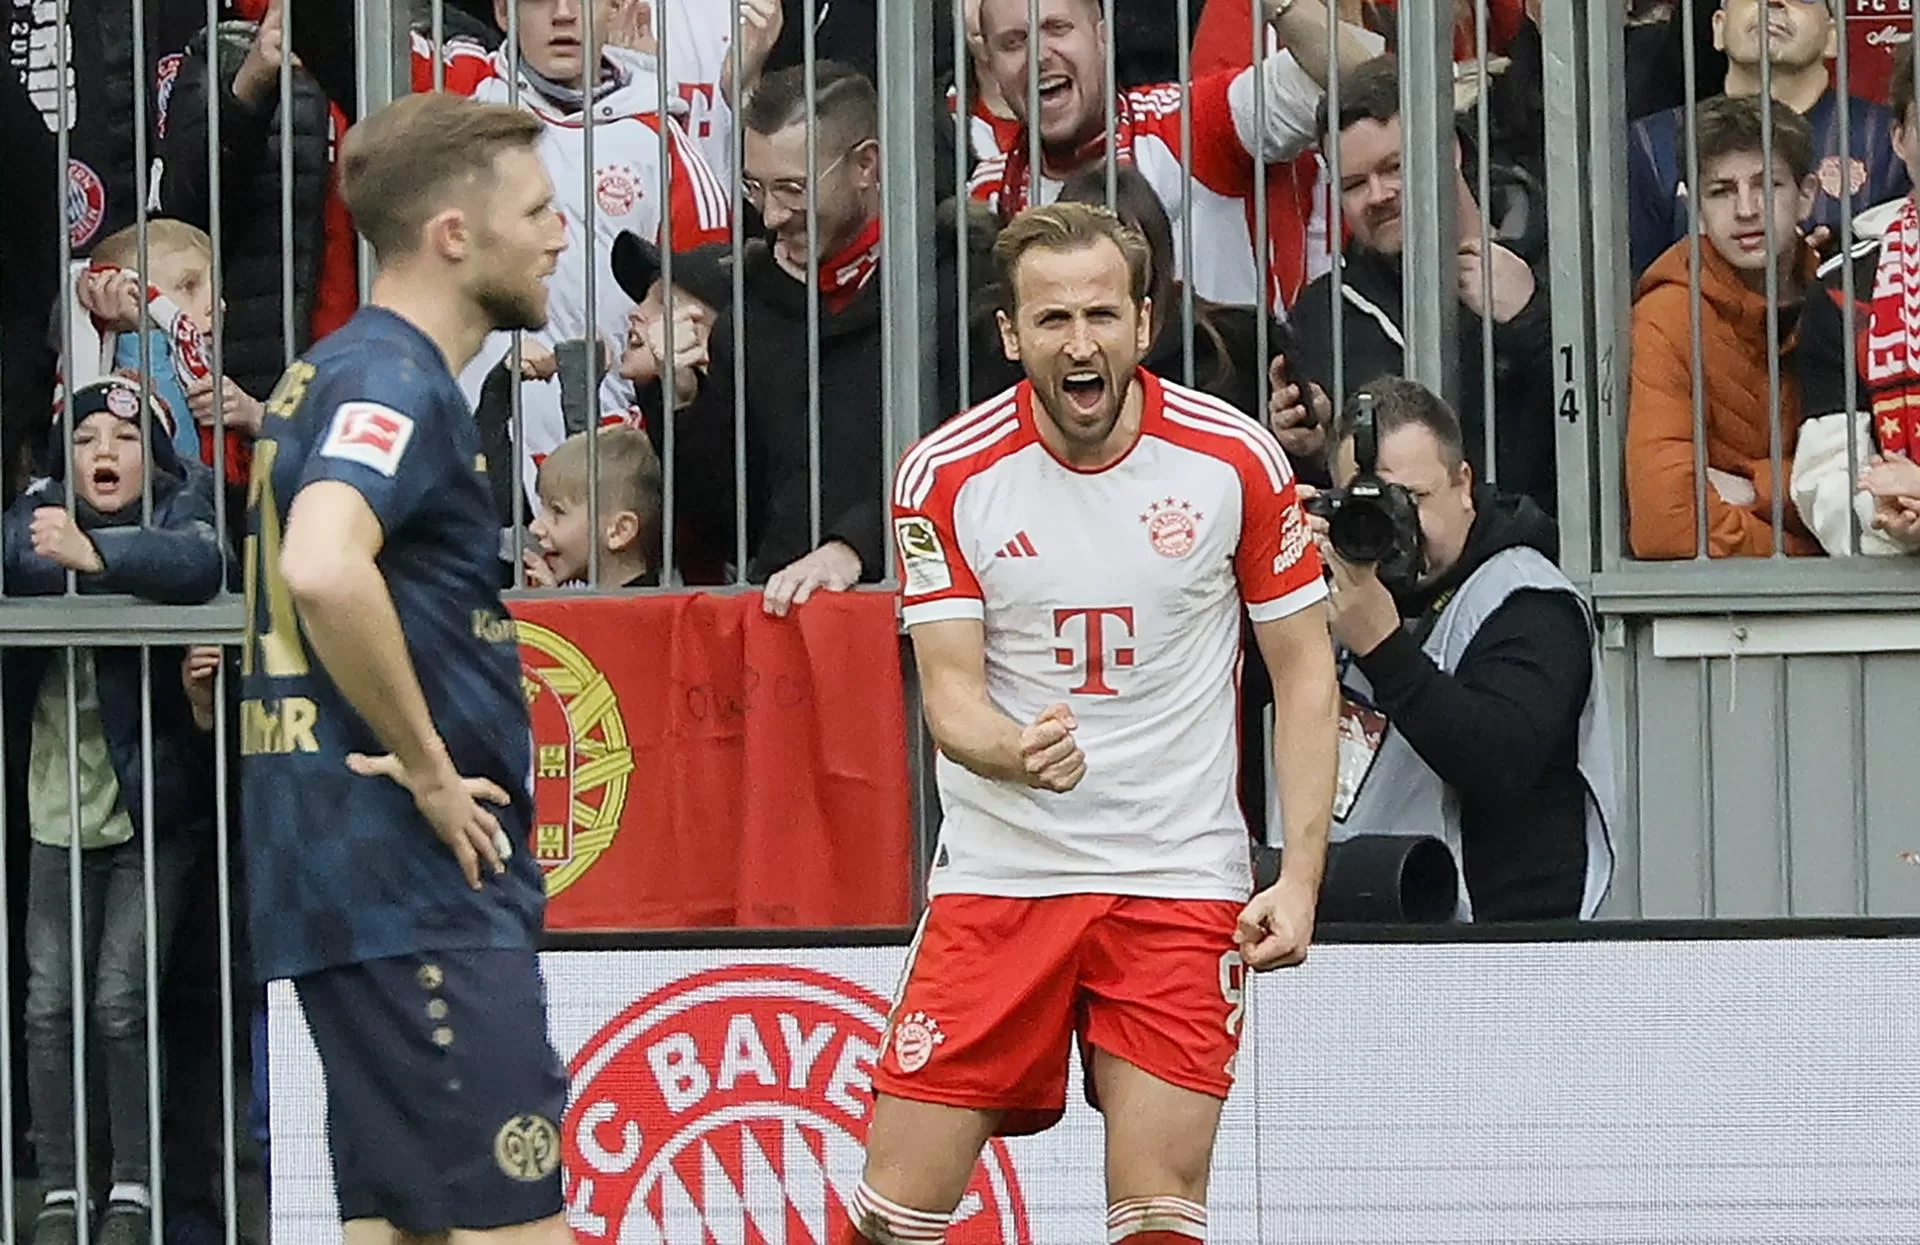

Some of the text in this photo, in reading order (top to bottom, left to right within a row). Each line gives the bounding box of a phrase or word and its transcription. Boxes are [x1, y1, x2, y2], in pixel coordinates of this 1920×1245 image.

[1053, 606, 1134, 695] T
[1219, 949, 1245, 1036] 9
[647, 1012, 881, 1119] BAYE
